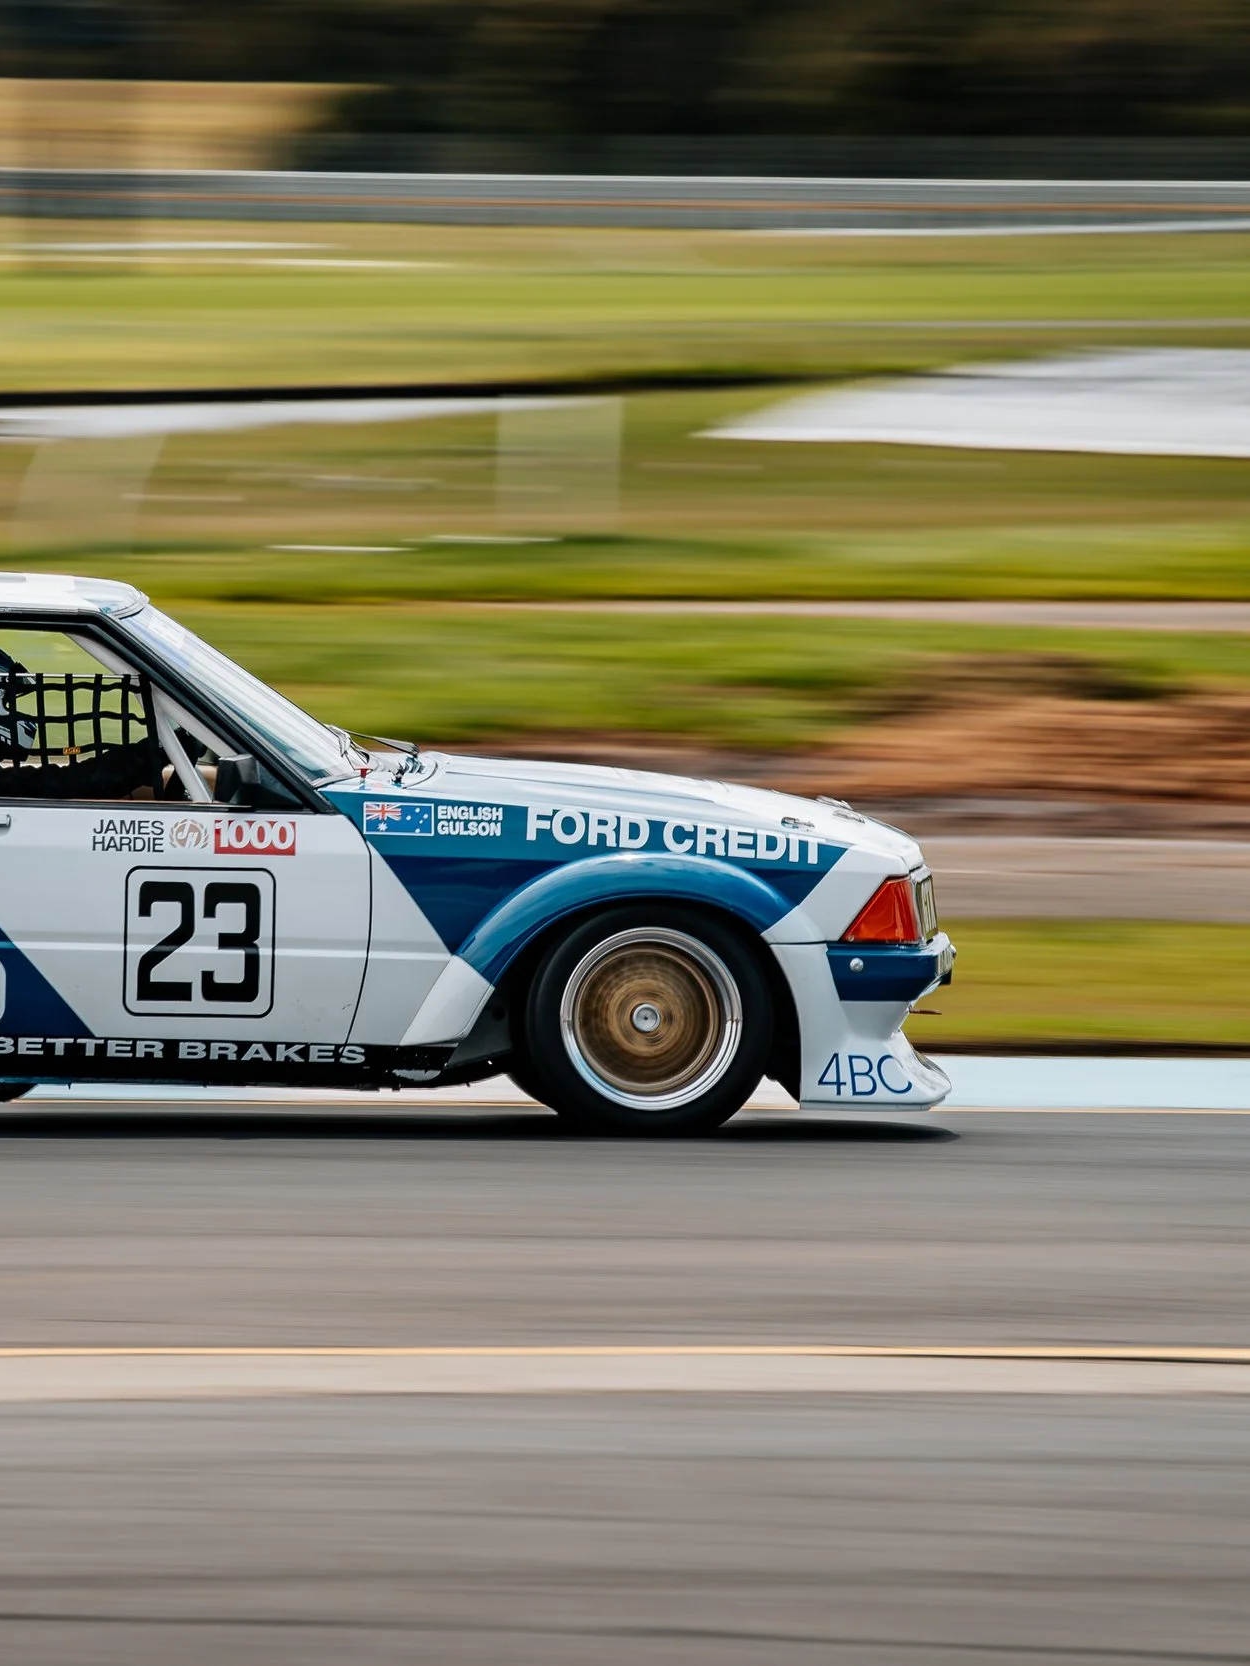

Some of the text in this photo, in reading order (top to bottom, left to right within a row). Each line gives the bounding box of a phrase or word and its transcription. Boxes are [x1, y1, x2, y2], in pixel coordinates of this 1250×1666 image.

[437, 805, 503, 821] ENGLISH
[93, 819, 165, 836] JAMES
[215, 820, 295, 849] 1000
[437, 821, 501, 836] GULSON
[526, 806, 826, 865] FORD CREDIT
[92, 836, 164, 853] HARDIE
[136, 881, 261, 1002] 23
[178, 1042, 366, 1063] BRAKES
[817, 1052, 913, 1096] 4BC
